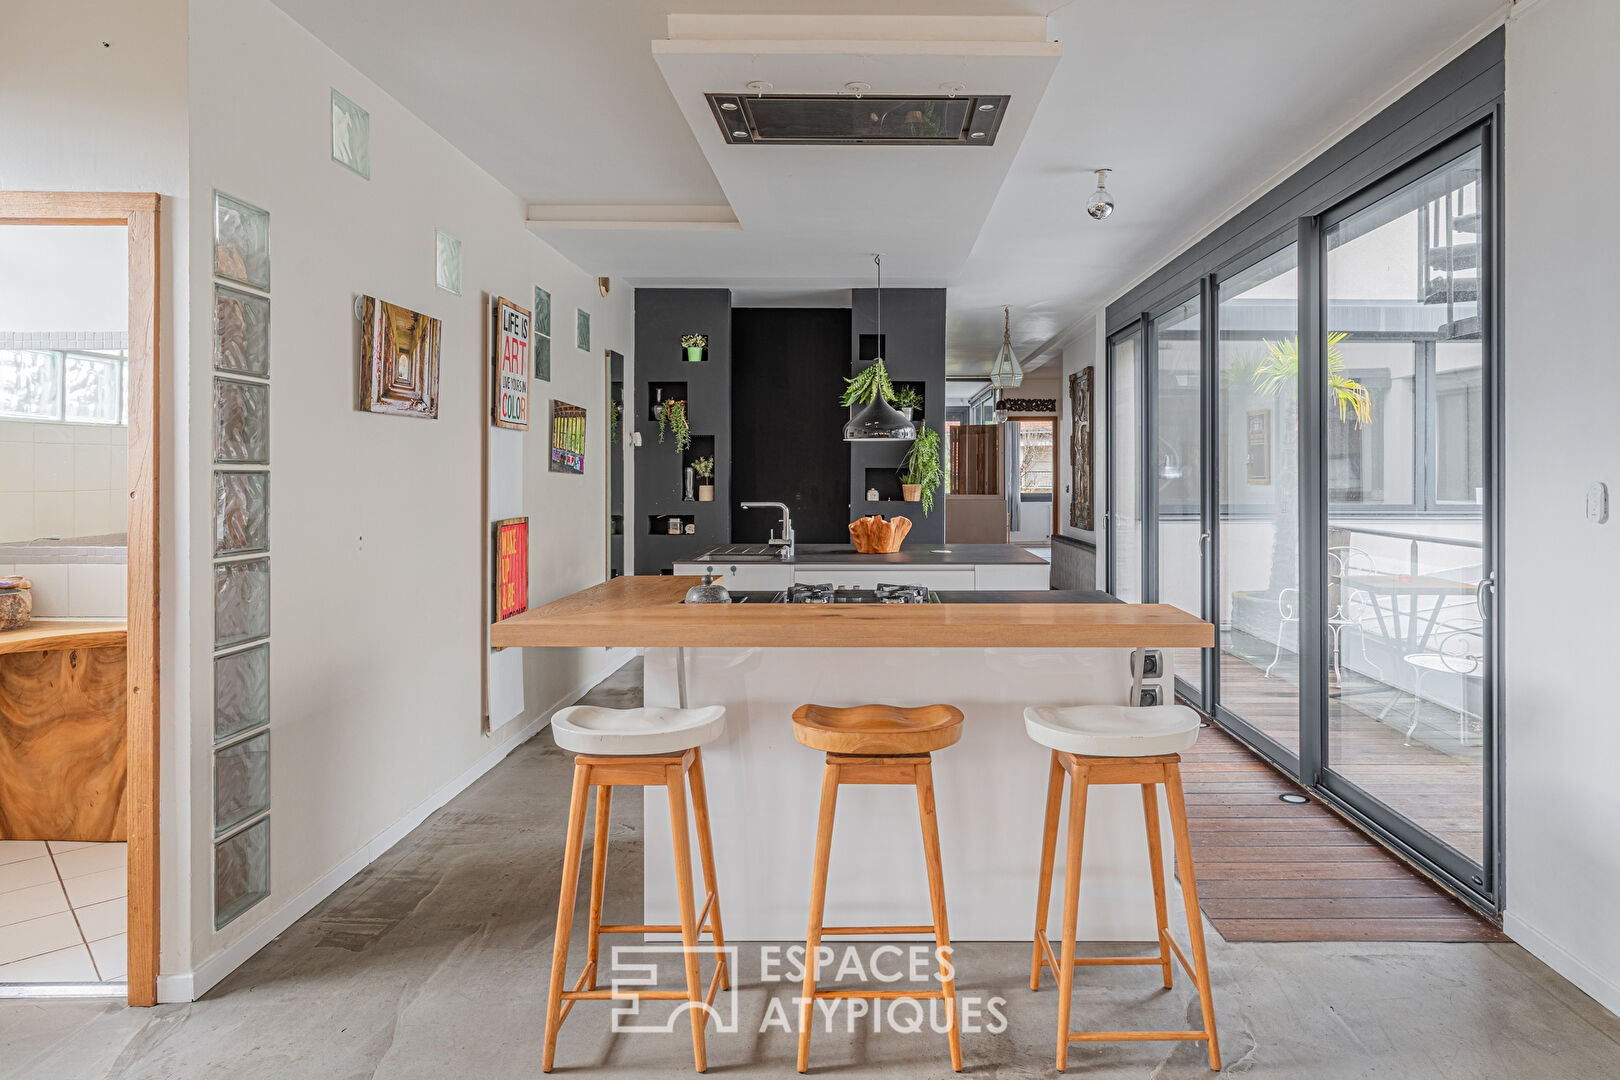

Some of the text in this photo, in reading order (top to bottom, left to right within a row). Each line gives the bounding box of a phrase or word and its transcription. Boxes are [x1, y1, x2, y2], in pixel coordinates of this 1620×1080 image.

[503, 309, 528, 339] LIFE IS
[502, 335, 527, 376] ART
[502, 376, 510, 389] LIVE
[502, 392, 526, 420] COLOR
[502, 558, 510, 583] UP
